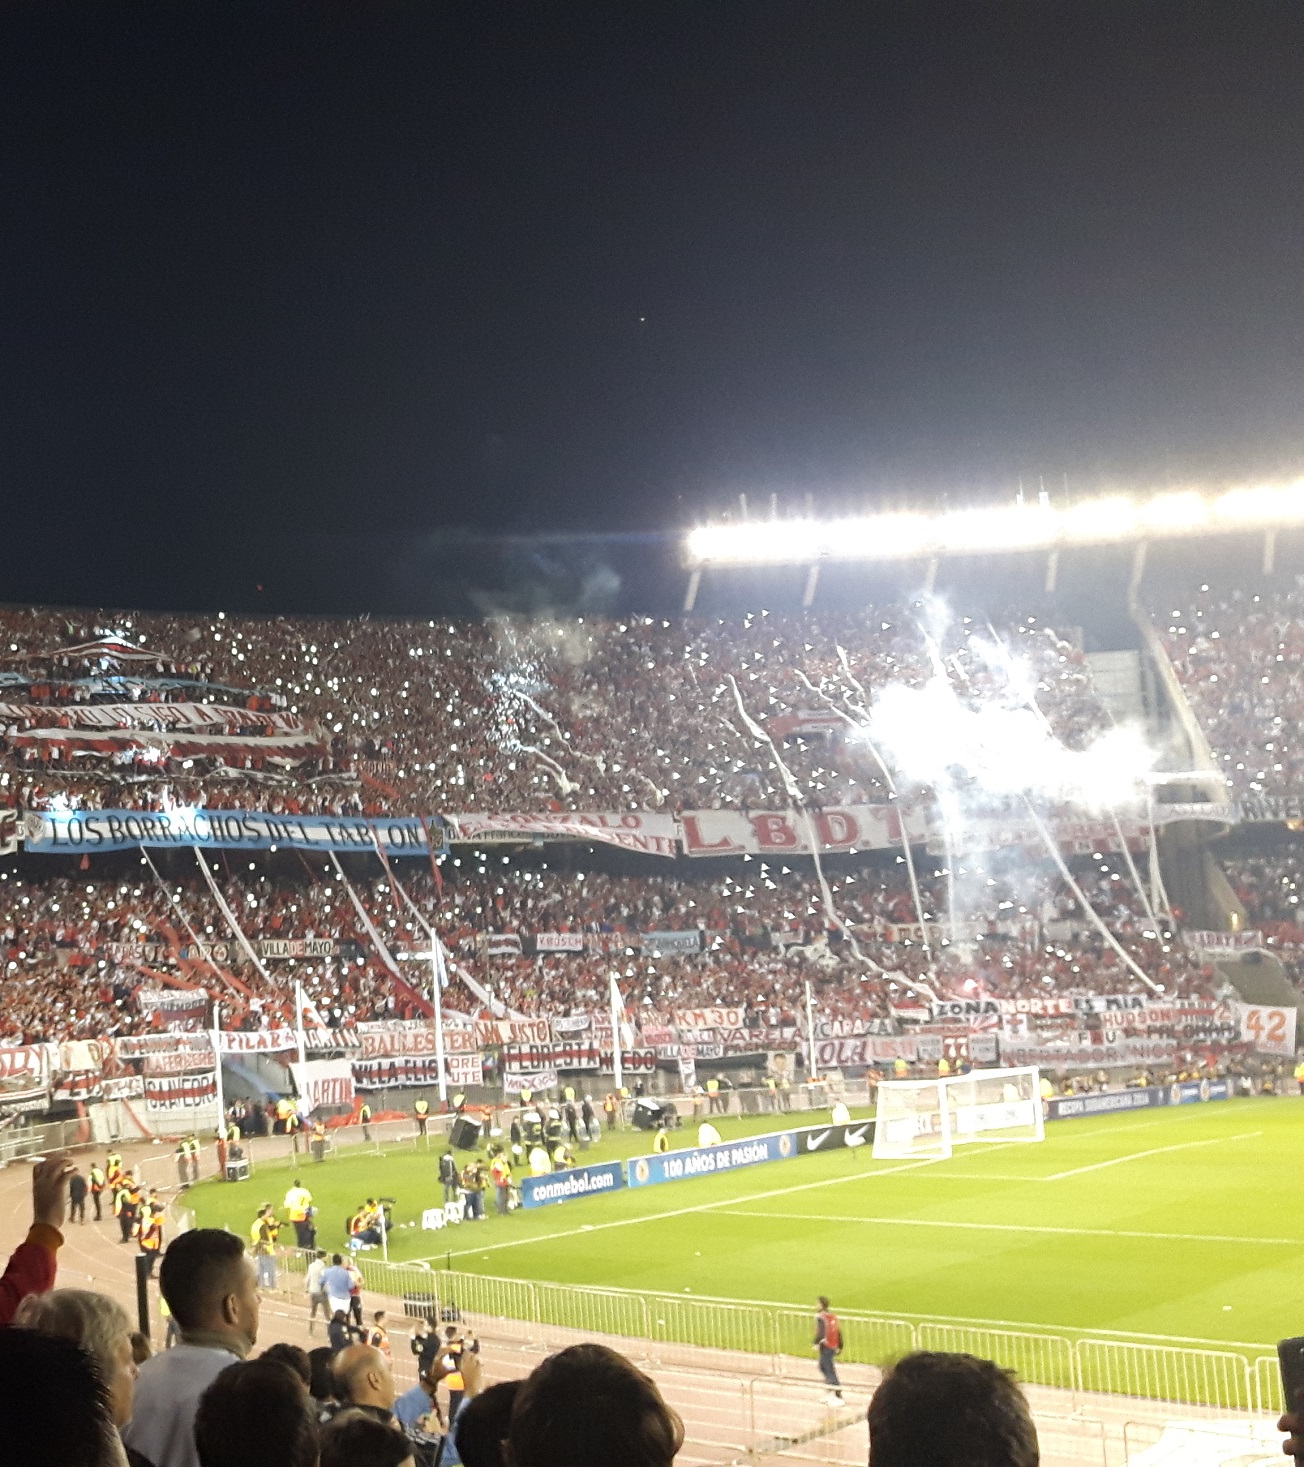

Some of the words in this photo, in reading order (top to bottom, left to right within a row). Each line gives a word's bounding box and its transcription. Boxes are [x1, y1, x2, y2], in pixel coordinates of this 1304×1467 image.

[50, 815, 100, 847] LOS
[107, 813, 262, 845] BORRACHOS
[265, 818, 318, 846] DEL
[319, 819, 422, 849] TABON
[262, 941, 289, 956] VILLA
[290, 941, 304, 955] DE
[305, 940, 331, 955] MAYO
[676, 1010, 707, 1026] KM
[713, 1009, 740, 1026] 30
[935, 1000, 999, 1016] ZONA
[999, 998, 1074, 1014] NORTE
[508, 1020, 547, 1044] JUSTO
[716, 1028, 804, 1044] VARELA
[1247, 1010, 1287, 1043] 42
[225, 1032, 282, 1051] PILAR
[508, 1040, 598, 1071] FLORESTA
[599, 1050, 655, 1071] HEDO
[351, 1060, 396, 1088] VILLA
[306, 1076, 353, 1106] ARTIN
[662, 1158, 683, 1179] 100
[684, 1151, 715, 1175] AÑOS
[716, 1149, 731, 1168] DE
[733, 1141, 769, 1166] PASIÓN
[532, 1170, 614, 1201] conmebol.com
